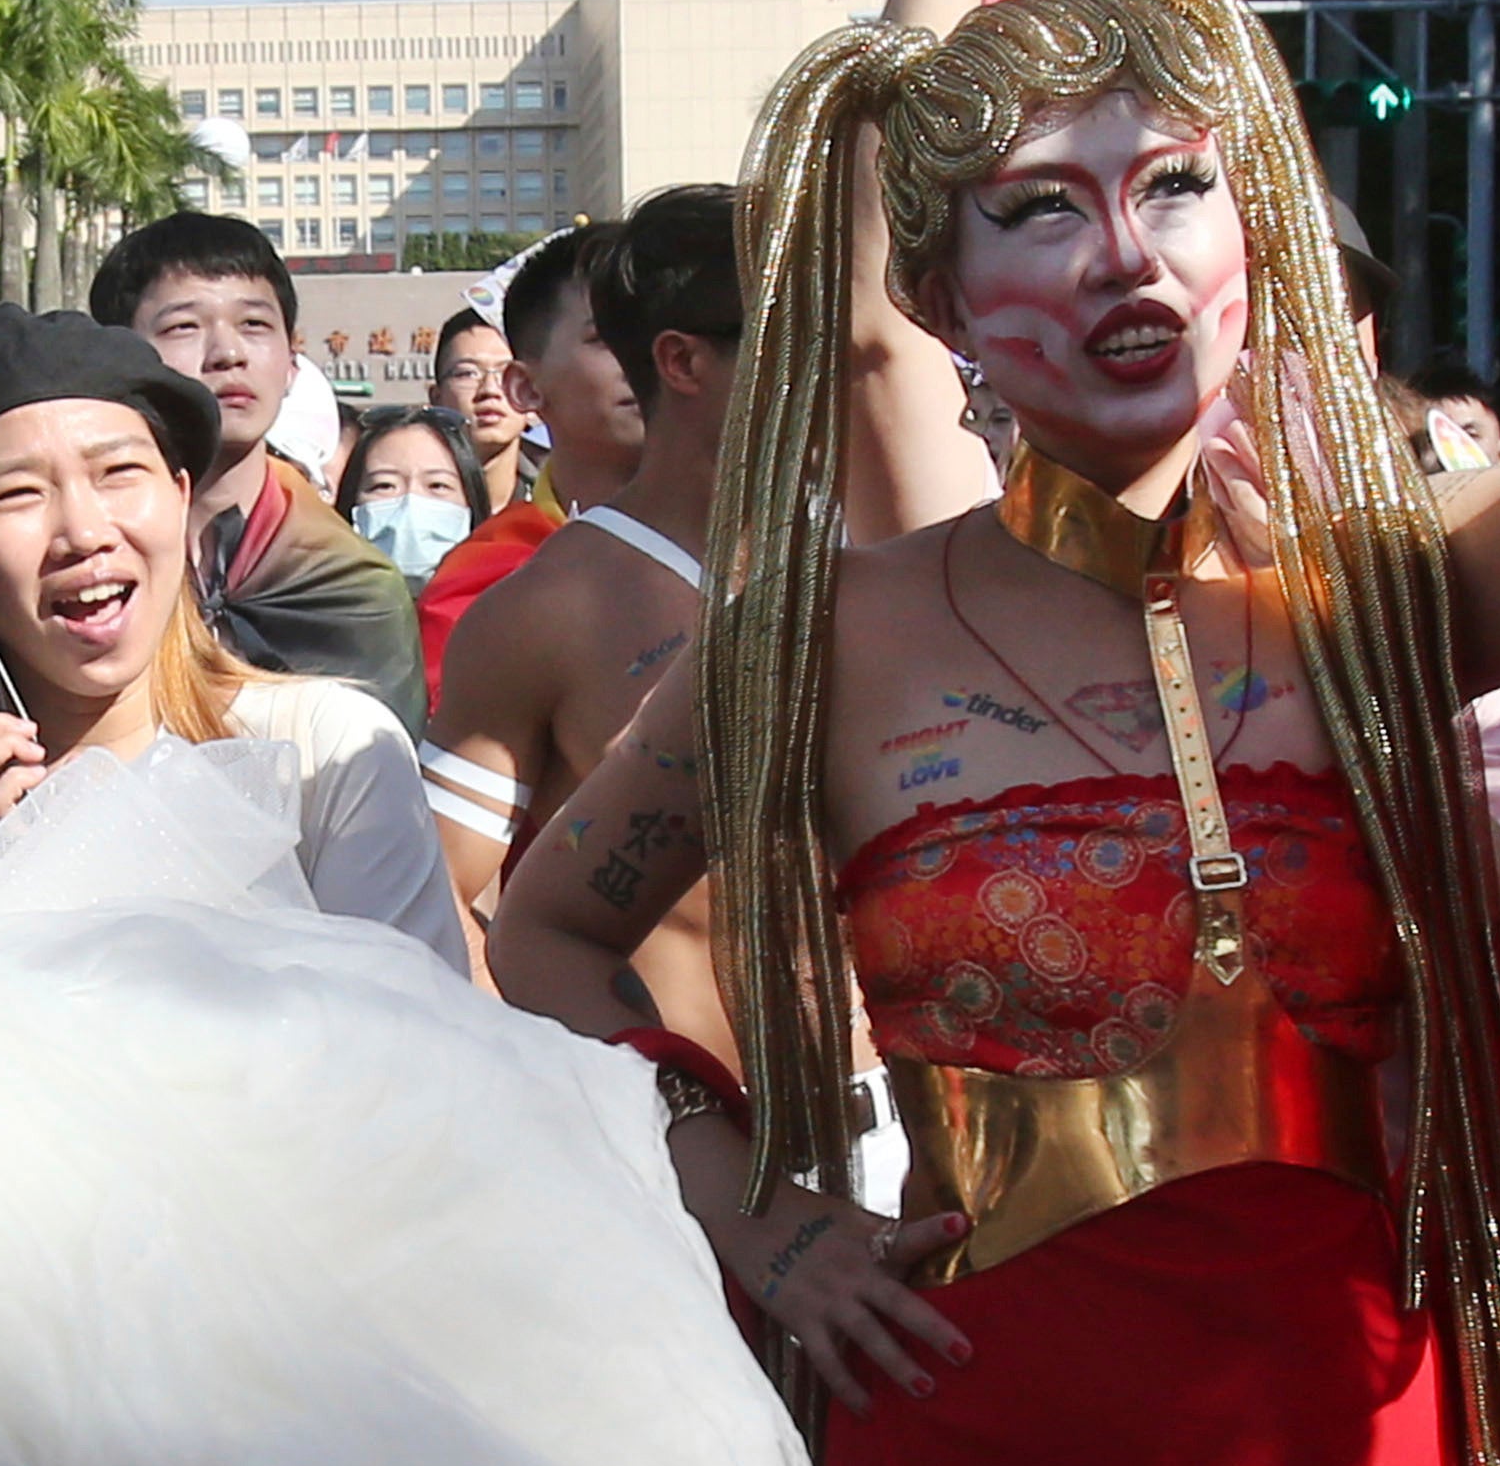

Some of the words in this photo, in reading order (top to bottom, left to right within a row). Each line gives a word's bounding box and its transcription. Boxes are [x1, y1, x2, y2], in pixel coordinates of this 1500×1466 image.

[384, 358, 437, 380] HALL
[966, 693, 1048, 734] tinder
[898, 758, 962, 791] LOVE
